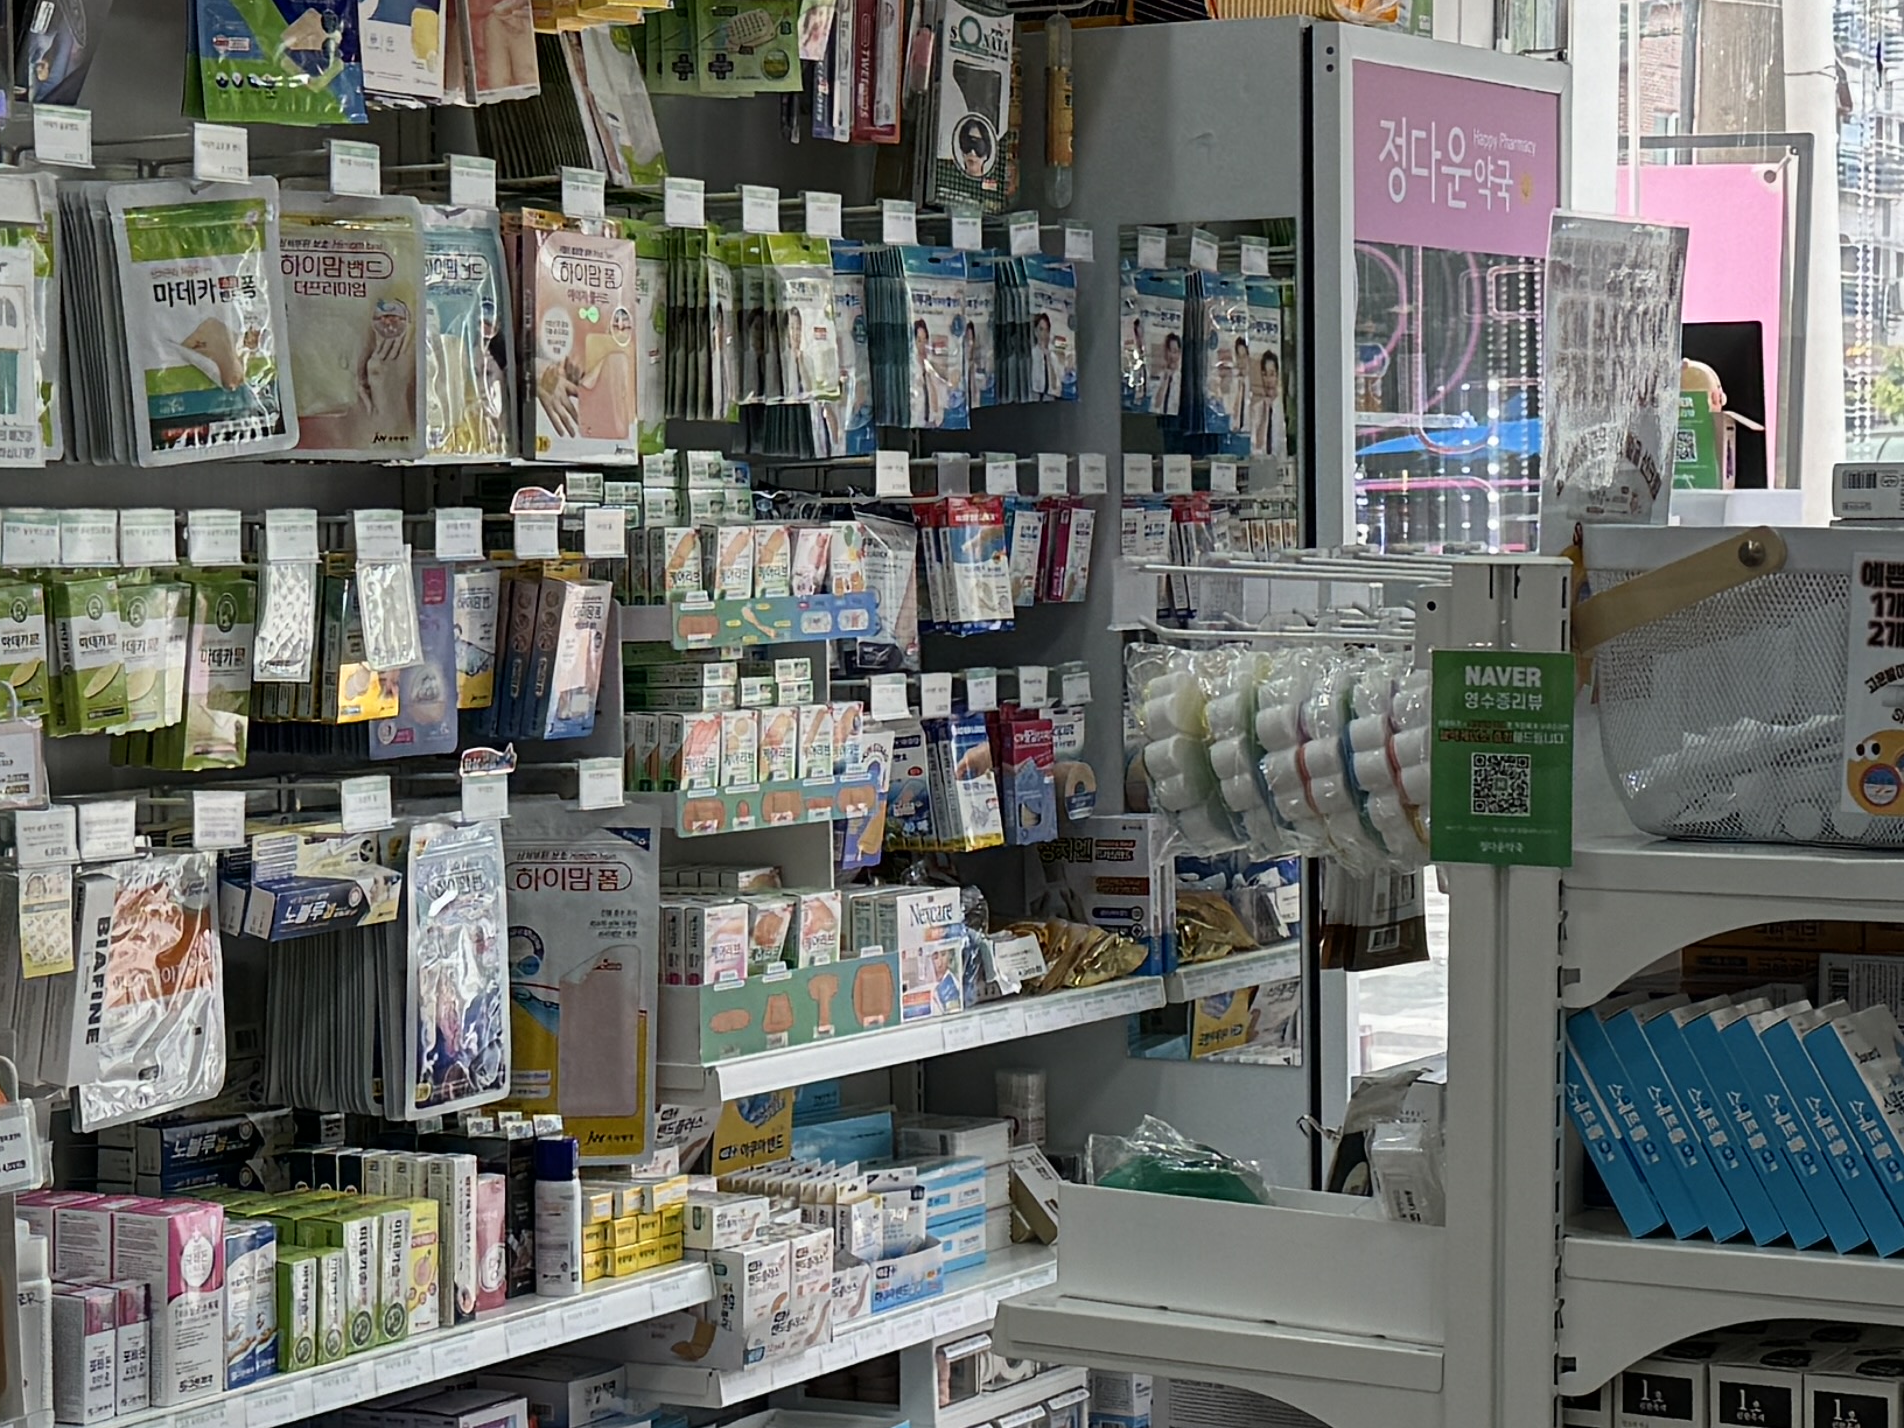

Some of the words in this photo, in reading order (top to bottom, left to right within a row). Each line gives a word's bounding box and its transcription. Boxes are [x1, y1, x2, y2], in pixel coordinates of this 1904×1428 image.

[1473, 129, 1497, 151] Happy
[1500, 133, 1536, 155] Pharmacy
[1380, 117, 1471, 208] 정다운
[1476, 156, 1513, 212] 약국
[281, 256, 343, 279] 하이맘
[602, 265, 618, 287] 폼
[1465, 666, 1542, 689] NAVER
[1465, 691, 1543, 712] 영수증리뷰
[516, 867, 590, 893] 하이맘
[596, 868, 620, 892] 폼
[909, 904, 954, 927] Nexcare
[85, 915, 111, 1047] BIAFINE
